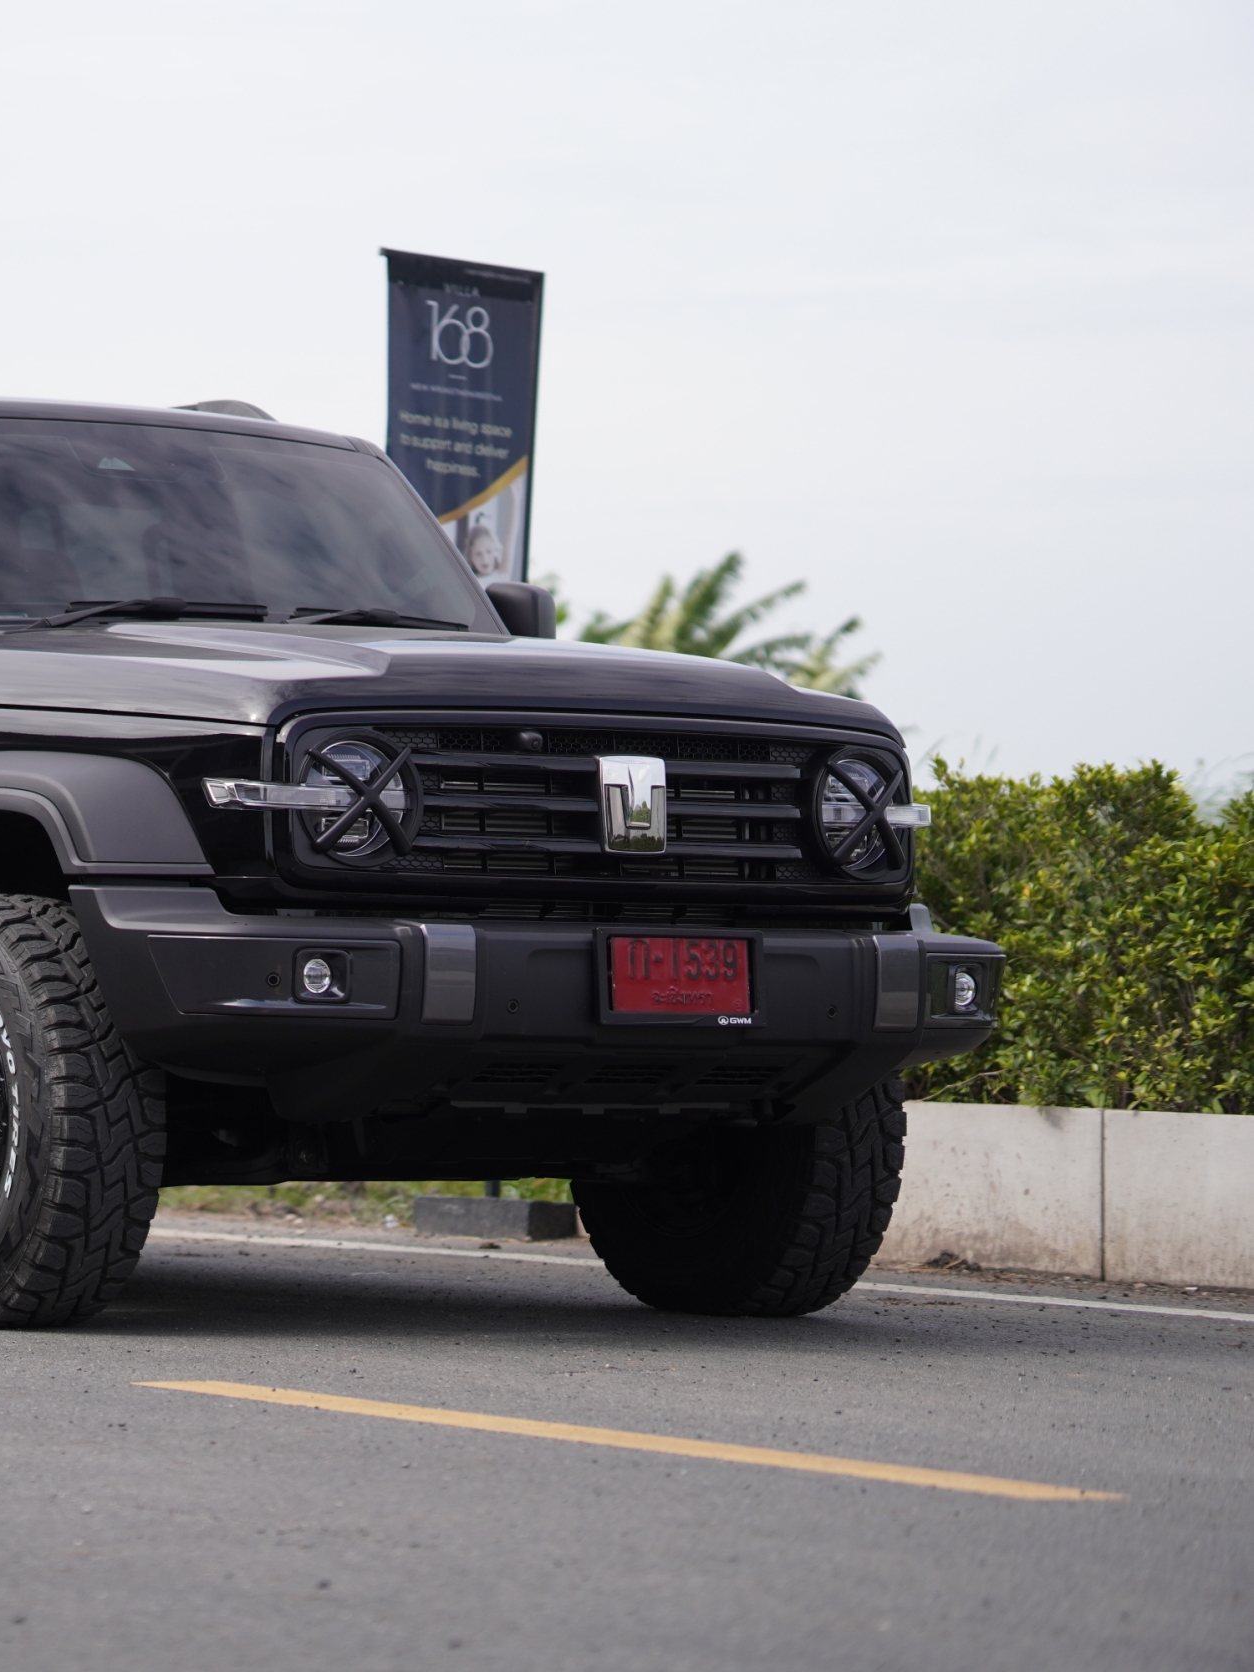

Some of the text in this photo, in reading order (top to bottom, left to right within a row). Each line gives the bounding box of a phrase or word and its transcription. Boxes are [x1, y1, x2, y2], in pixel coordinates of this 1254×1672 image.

[426, 300, 494, 369] 168
[399, 410, 431, 426] Home
[452, 417, 479, 436] living
[481, 423, 513, 438] space
[411, 437, 452, 451] support
[454, 441, 473, 454] and
[474, 444, 510, 459] deliver
[729, 1017, 752, 1025] GWM
[3, 1080, 20, 1199] TIRES
